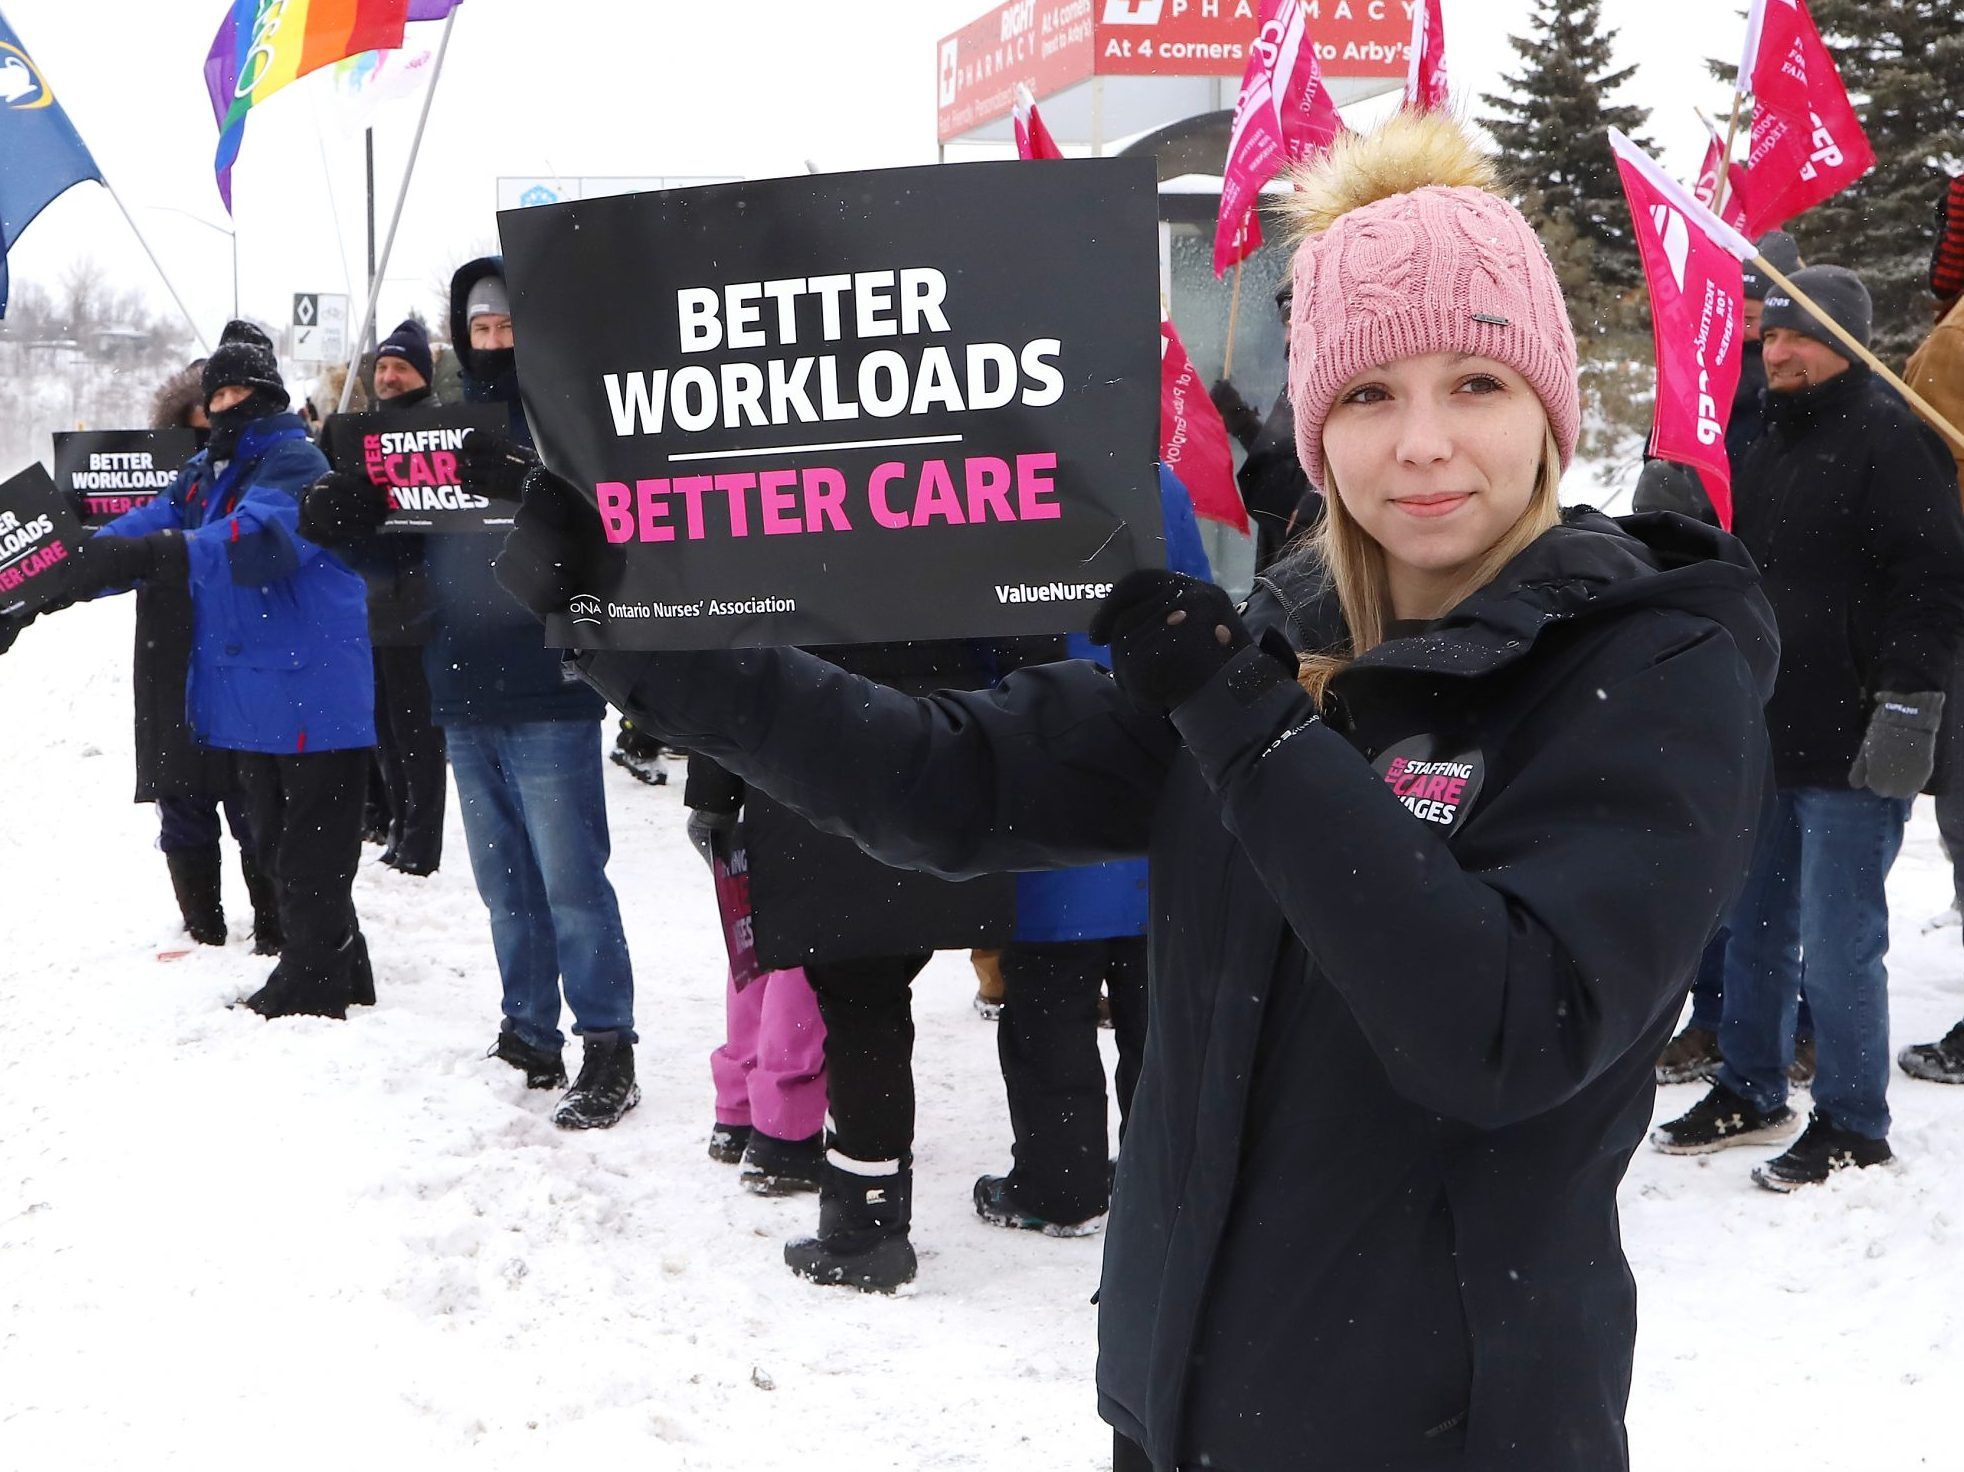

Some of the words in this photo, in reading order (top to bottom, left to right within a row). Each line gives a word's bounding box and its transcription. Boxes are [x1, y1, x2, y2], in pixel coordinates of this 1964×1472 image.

[1000, 0, 1037, 42] RIGHT
[1172, 0, 1416, 20] PHAMACY
[957, 31, 1036, 92] PHARMACY
[1104, 39, 1132, 58] At
[1137, 39, 1153, 57] 4
[1159, 42, 1243, 59] corners
[1313, 41, 1337, 60] to
[676, 266, 952, 354] BETTER
[603, 338, 1066, 437] WORKLOADS
[89, 452, 154, 471] BETTER
[384, 452, 463, 487] CAR
[71, 470, 179, 490] WORKLOADS
[595, 466, 853, 544] BETTER
[867, 452, 1062, 529] CARE
[0, 513, 54, 561] LOADS
[20, 539, 70, 578] CARE
[607, 602, 651, 619] Ontario
[708, 596, 796, 616] Association
[1403, 760, 1474, 780] STAFFING
[1392, 773, 1468, 806] CARE
